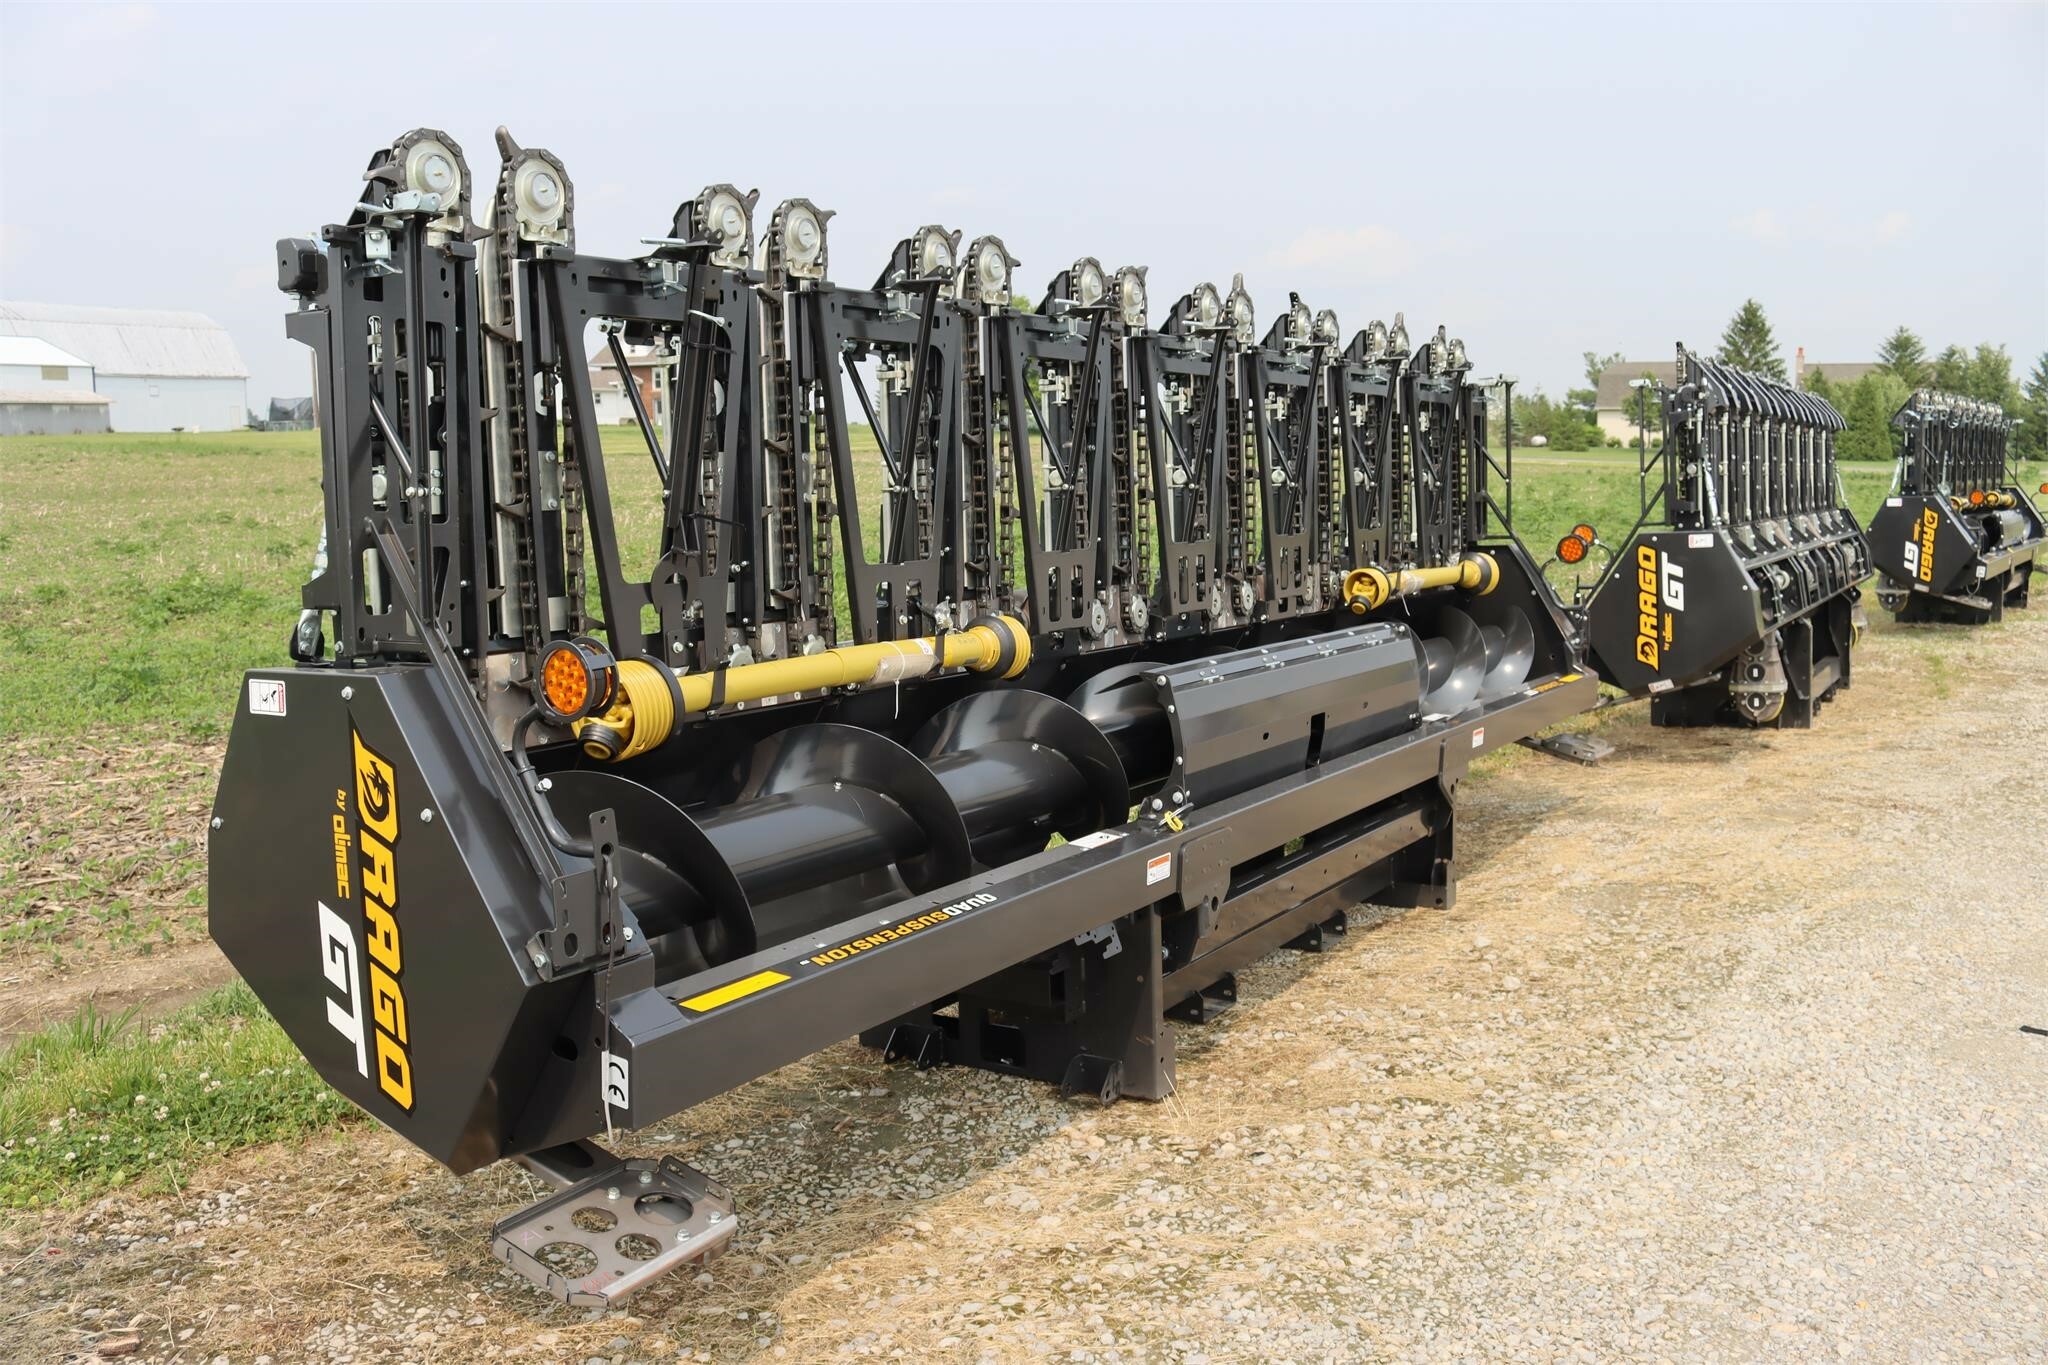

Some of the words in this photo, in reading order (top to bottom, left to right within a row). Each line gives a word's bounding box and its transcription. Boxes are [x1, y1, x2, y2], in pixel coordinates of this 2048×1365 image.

[1661, 551, 1685, 612] GT
[1904, 541, 1919, 578] GT
[1919, 507, 1939, 582] DRAGO
[1637, 545, 1659, 671] DRAGO
[336, 788, 347, 812] by
[332, 814, 352, 900] olimac
[353, 728, 413, 1110] DRAGO
[810, 892, 998, 967] QUADSUSPENSION
[317, 900, 369, 1079] GT
